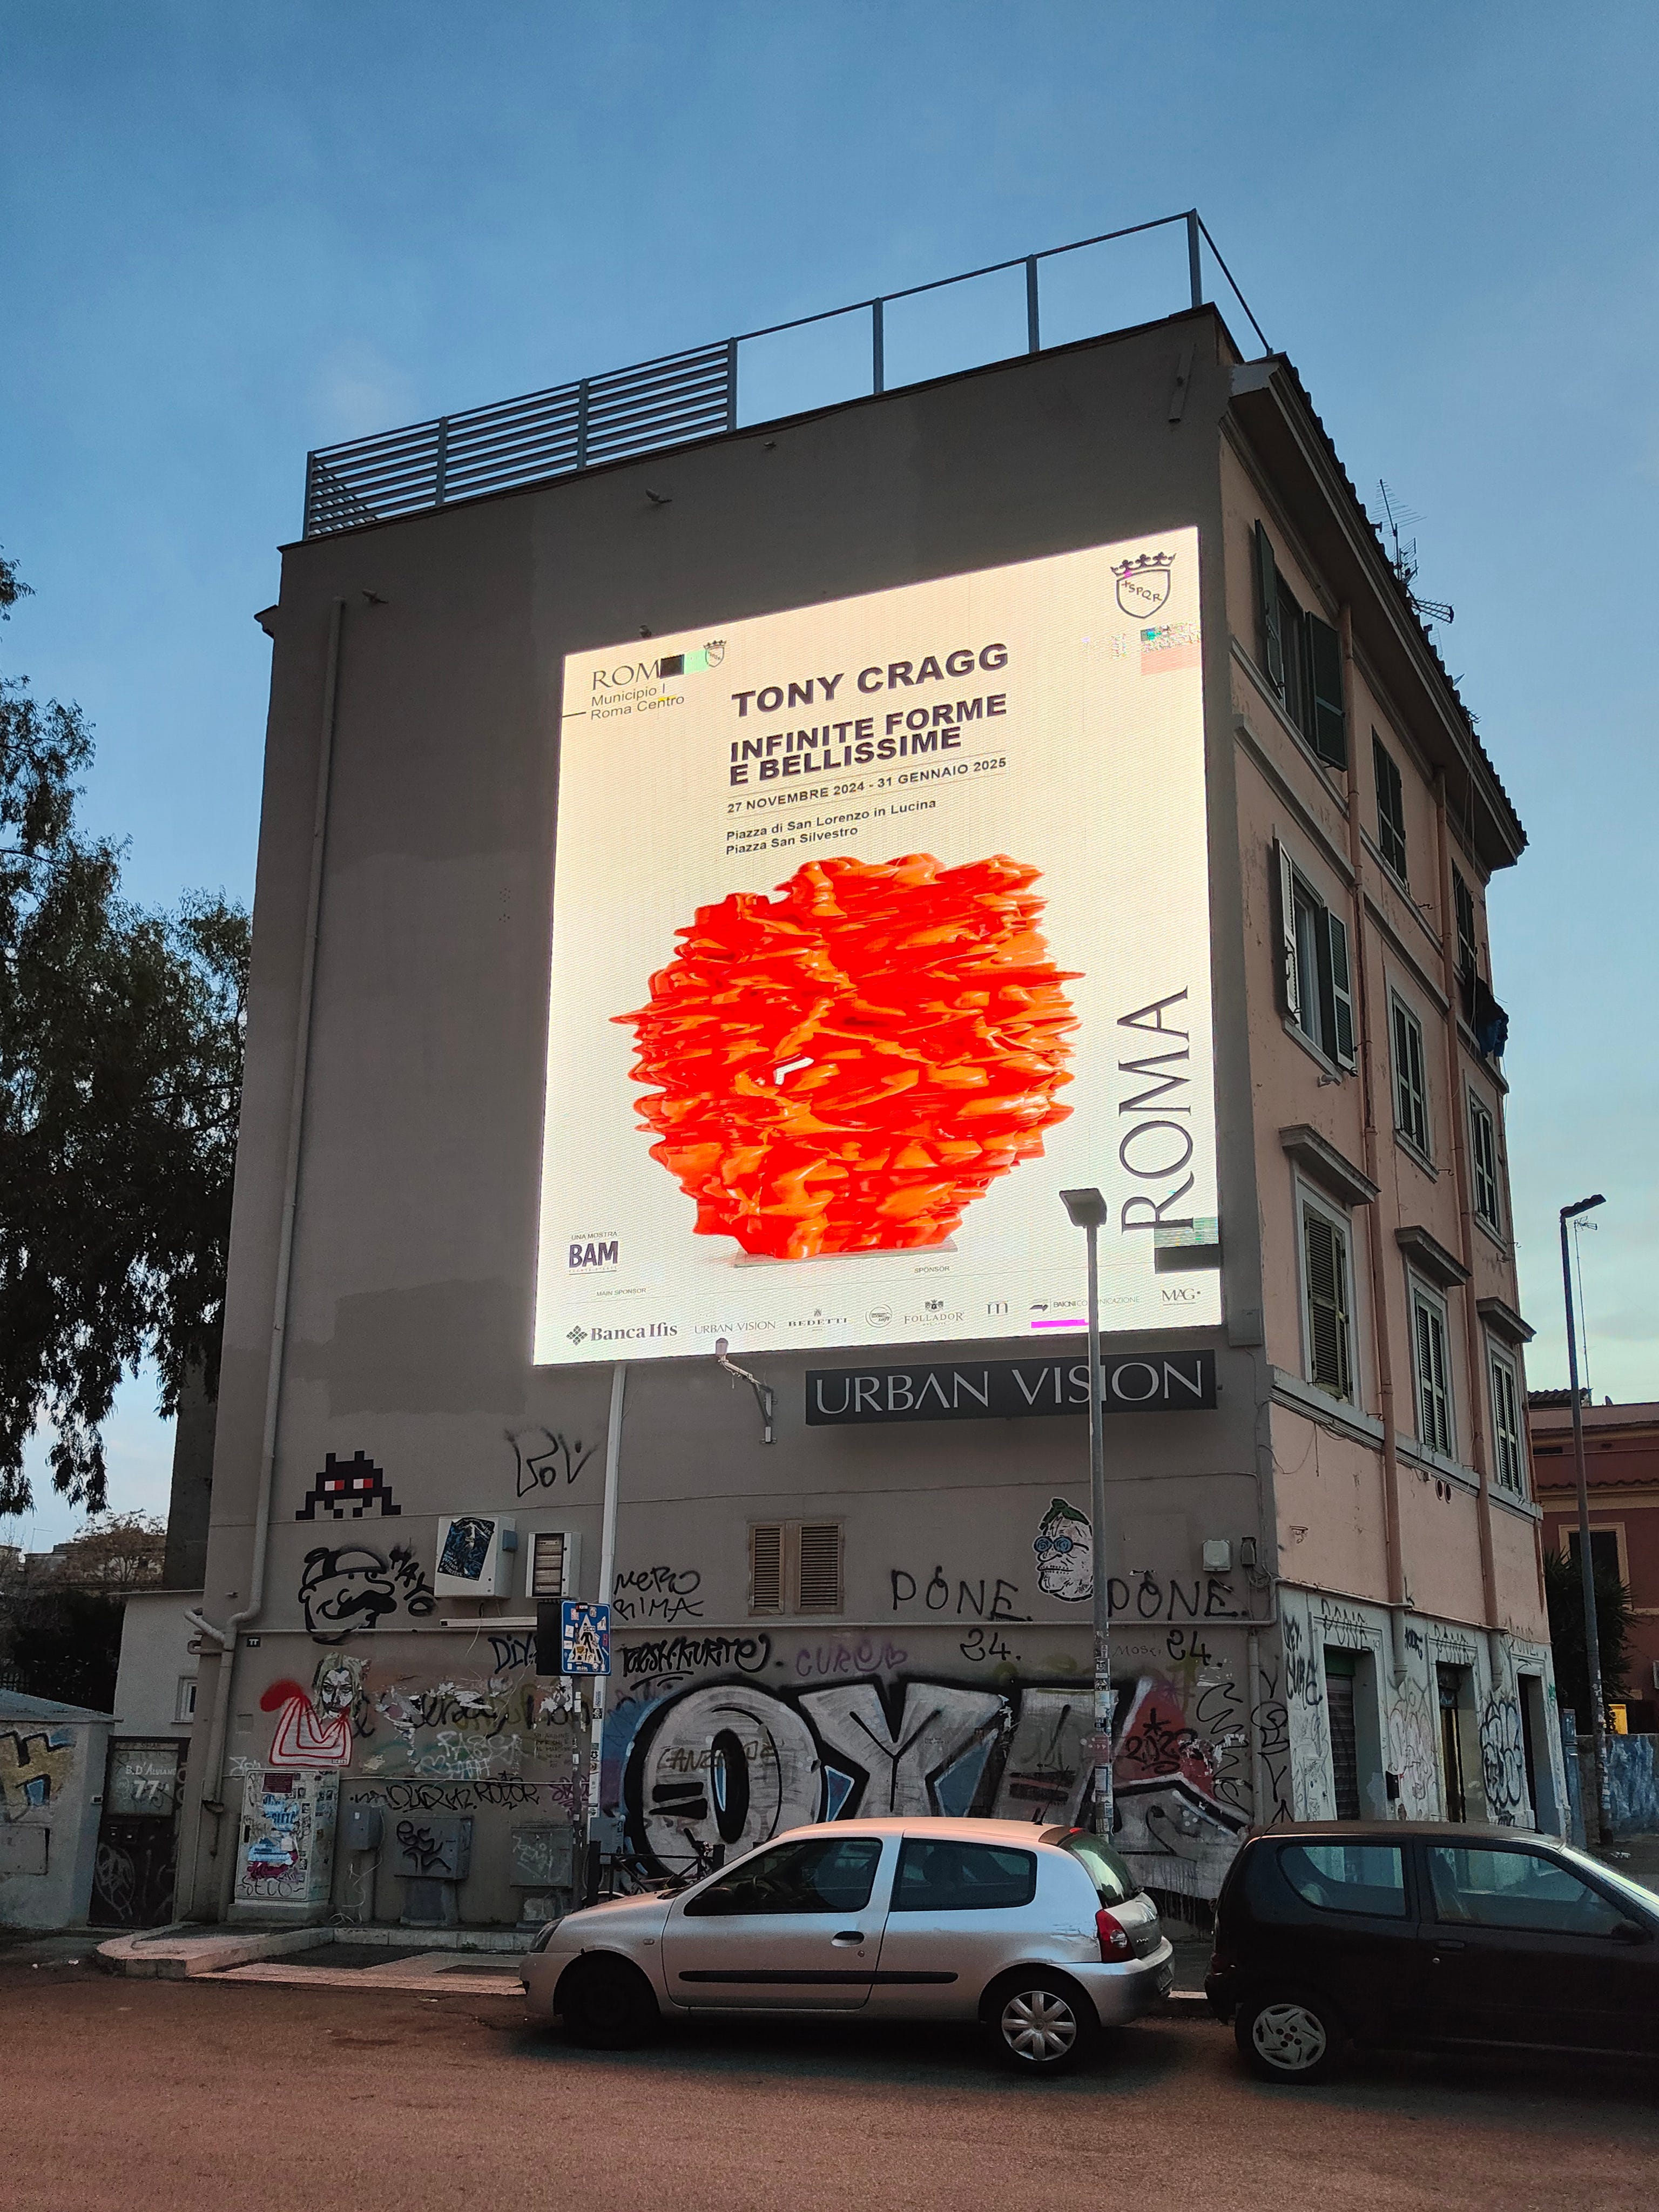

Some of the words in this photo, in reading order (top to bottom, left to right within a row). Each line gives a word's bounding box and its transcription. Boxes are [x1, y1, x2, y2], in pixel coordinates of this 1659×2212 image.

[731, 672, 845, 718] TONY
[857, 642, 1008, 694] CRAGG
[590, 706, 632, 720] Roma
[637, 695, 685, 712] Centro
[591, 686, 657, 707] Municipio
[730, 717, 875, 763] INFINITE
[885, 693, 1008, 736] FORME
[730, 763, 749, 786] E
[759, 725, 962, 781] BELLISSIME
[727, 802, 743, 814] 27
[746, 786, 830, 811] NOVEMBRE
[833, 781, 865, 797] 2024
[877, 776, 893, 789] 31
[898, 764, 969, 785] GENNAIO
[973, 757, 1008, 772] 2025
[726, 825, 768, 841] Piazza
[771, 822, 783, 834] di
[787, 818, 812, 831] San
[816, 808, 870, 827] Lorenzo
[873, 807, 886, 818] in
[891, 798, 937, 815] Lucina
[725, 841, 767, 856] Piazza
[771, 836, 796, 848] San
[799, 825, 859, 844] Silvestro
[1116, 984, 1195, 1236] ROMA
[571, 1233, 586, 1241] UNA
[587, 1231, 618, 1239] MOSTRA
[569, 1240, 619, 1268] BAM
[914, 1265, 950, 1274] SPONSOR
[614, 1287, 646, 1296] SPONSOR
[694, 1323, 733, 1334] URBAN
[737, 1320, 776, 1331] VISION
[788, 1317, 848, 1327] BEDETTI
[904, 1312, 963, 1324] FOLLADOR
[590, 1326, 645, 1341] Banca
[649, 1323, 678, 1338] Ifis
[815, 1371, 990, 1414] URBAN
[1011, 1360, 1203, 1406] VISION
